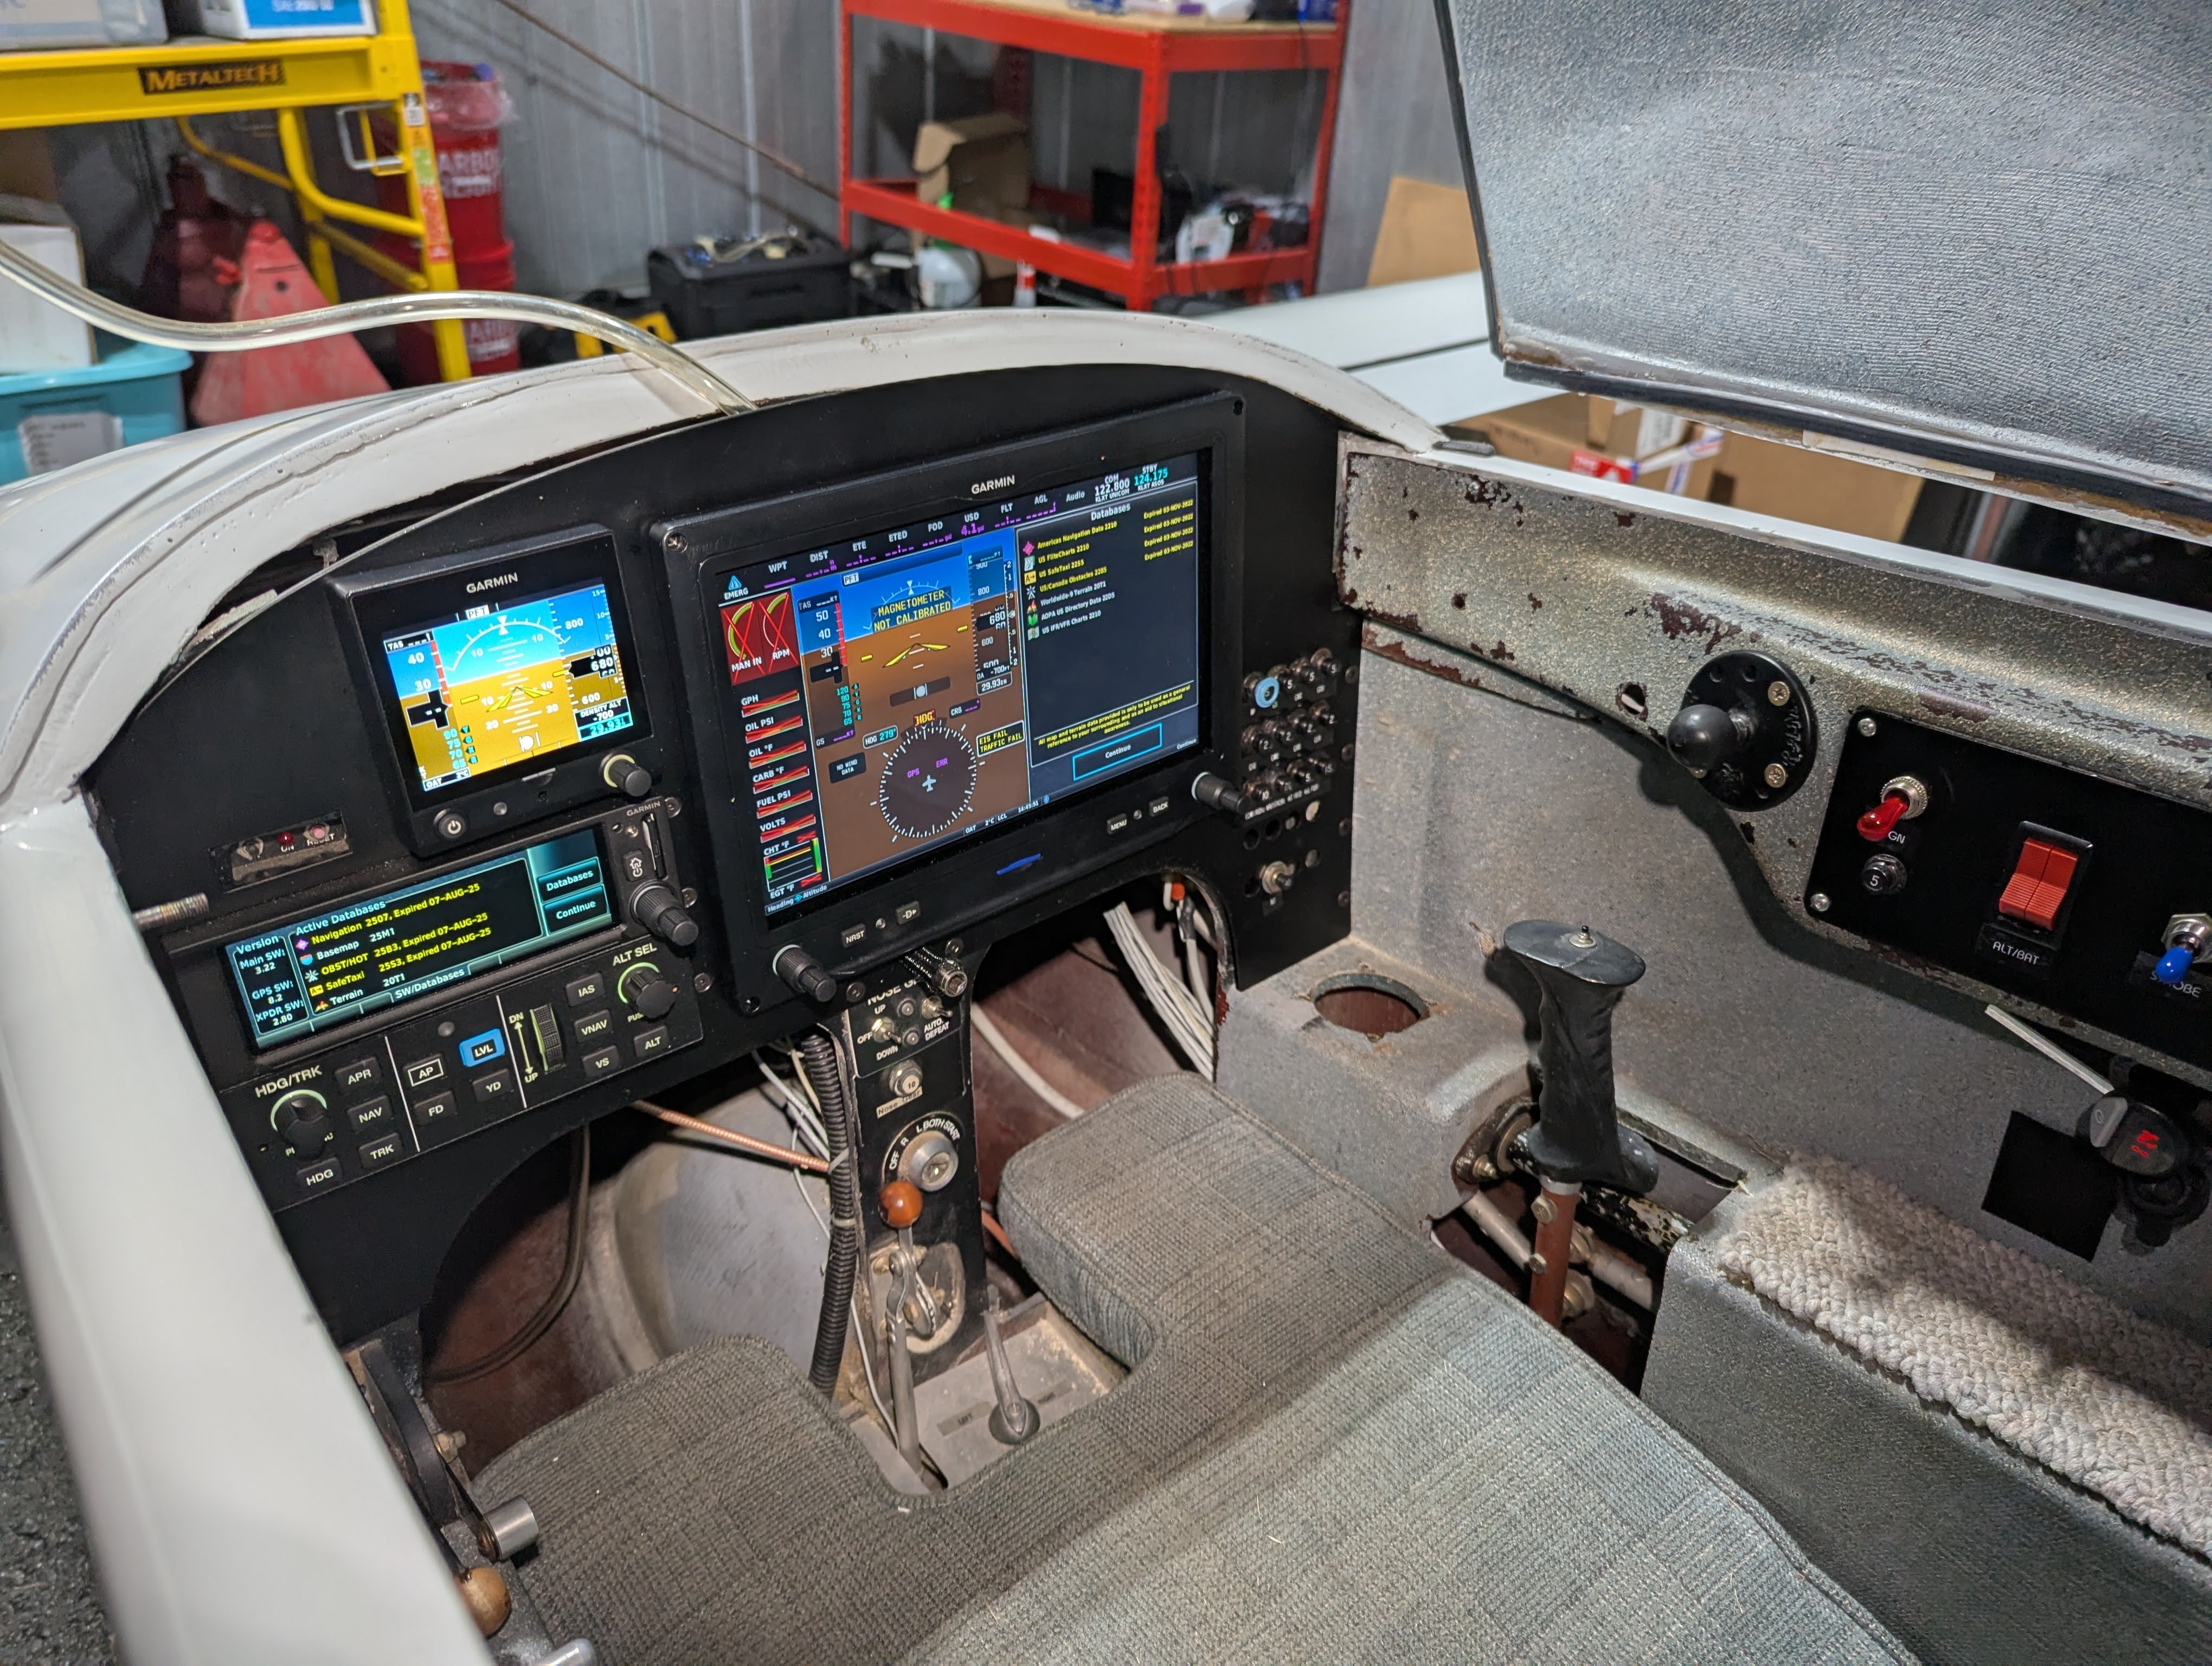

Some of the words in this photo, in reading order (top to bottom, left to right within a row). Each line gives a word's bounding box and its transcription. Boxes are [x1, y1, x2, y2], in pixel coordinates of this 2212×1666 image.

[1104, 473, 1119, 484] COM
[1134, 467, 1168, 486] 124.175
[971, 474, 1015, 495] GARMIN
[1095, 477, 1130, 497] 122.800
[1091, 503, 1130, 521] Databases
[723, 587, 749, 600] EMERG
[768, 561, 788, 573] WPT
[809, 550, 829, 563] DIST
[852, 541, 867, 552] ETE
[889, 529, 908, 543] ETED
[928, 521, 943, 533] FOD
[964, 511, 979, 523] USD
[1001, 502, 1013, 514] FLT
[1034, 494, 1048, 505] AGL
[1066, 490, 1085, 503] Audio
[1037, 538, 1062, 549] Americas
[1063, 530, 1090, 543] Navigation
[466, 573, 518, 594] GARMIN
[845, 574, 858, 584] PFT
[1040, 579, 1068, 592] US/Canada
[1069, 571, 1094, 583] Obstacles
[978, 586, 989, 596] 800
[1074, 585, 1092, 596] Terrain
[799, 600, 811, 610] TAS
[878, 589, 944, 617] MAGNETOMETER
[1041, 611, 1056, 620] AOPA
[1065, 601, 1088, 613] Directory
[1089, 596, 1102, 605] Data
[468, 607, 486, 618] PFT
[816, 610, 828, 622] 50
[874, 618, 890, 632] NOT
[896, 601, 951, 625] CALIBRATED
[989, 611, 1006, 625] 680
[565, 617, 584, 630] 800
[1071, 615, 1088, 625] Charts
[819, 627, 831, 639] 40
[387, 640, 404, 651] TAS
[981, 637, 993, 646] 600
[408, 652, 425, 664] 40
[772, 649, 790, 660] RPM
[821, 646, 833, 658] 30
[591, 657, 613, 671] 680
[732, 659, 750, 672] MAN
[753, 656, 762, 666] IN
[1331, 664, 1337, 674] 5
[1309, 672, 1315, 682] 5
[415, 678, 432, 691] 30
[1287, 680, 1293, 689] 5
[581, 692, 601, 705] 600
[741, 694, 759, 706] GPH
[580, 705, 607, 719] DENSITY
[609, 699, 622, 710] ALT
[745, 721, 759, 732] OIL
[760, 716, 774, 727] PSI
[916, 712, 933, 726] HDG
[1069, 724, 1086, 734] terrain
[1098, 710, 1121, 725] provided
[979, 735, 992, 745] EIS
[993, 729, 1008, 740] FAIL
[980, 738, 1006, 753] TRAFFIC
[1008, 733, 1023, 744] FAIL
[1047, 736, 1071, 749] reference
[749, 747, 763, 758] OIL
[1105, 745, 1131, 758] Continue
[753, 768, 775, 783] CARB
[907, 768, 920, 778] GPS
[426, 778, 442, 788] OAT
[756, 794, 776, 808] FUEL
[777, 790, 791, 802] PSI
[626, 800, 660, 817] GARMIN
[1153, 802, 1168, 813] BACK
[965, 825, 976, 834] OAT
[997, 813, 1007, 822] LCL
[1018, 799, 1039, 814] 14:45:51
[760, 817, 786, 832] VOLTS
[1110, 819, 1127, 831] MENU
[1888, 830, 1906, 844] GN
[763, 844, 780, 856] CHT
[546, 869, 594, 892] Databases
[1870, 874, 1880, 887] 5
[767, 898, 794, 913] Heading
[803, 885, 827, 899] Altitude
[770, 887, 785, 899] EGT
[311, 923, 362, 945] Navigation
[365, 913, 393, 927] 2507,
[393, 900, 428, 918] Expired
[428, 883, 480, 906] 07-AUG-25
[556, 900, 596, 920] Continue
[295, 918, 329, 936] Active
[331, 899, 386, 925] Databases
[236, 935, 279, 954] Version
[317, 940, 359, 960] Basemap
[369, 927, 395, 943] 25M1
[321, 953, 369, 975] OBST/HOT
[373, 943, 402, 958] 25B3,
[402, 930, 436, 948] Expired
[437, 912, 488, 935] 07-AUG-25
[846, 931, 864, 944] NRST
[240, 954, 264, 970] Main
[265, 949, 285, 961] SW:
[326, 970, 365, 991] SafeTaxi
[378, 958, 405, 972] 25S3,
[406, 945, 440, 963] Expired
[441, 927, 492, 951] 07-AUG-25
[613, 950, 632, 966] ALT
[635, 943, 657, 957] SEL
[1992, 940, 2040, 965] ALT/BAT
[255, 962, 276, 975] 3.22
[252, 986, 273, 1000] GPS
[274, 980, 294, 992] SW:
[329, 989, 364, 1005] Terrain
[382, 973, 405, 987] 20T1
[395, 969, 465, 999] SW/Databases
[578, 984, 595, 997] IAS
[2149, 971, 2202, 998] SOBE
[268, 994, 283, 1004] 8.2
[255, 1007, 283, 1022] XPDR
[285, 999, 304, 1011] SW:
[874, 1004, 886, 1015] UP
[272, 1014, 293, 1026] 2.80
[509, 1012, 524, 1024] DN
[581, 1019, 607, 1036] VNAV
[924, 1018, 944, 1033] AUTO.
[925, 1021, 950, 1041] DEFEAT
[645, 1036, 661, 1050] ALT
[857, 1031, 873, 1044] OFF
[474, 1044, 493, 1057] LVL
[876, 1046, 898, 1061] DOWN
[595, 1058, 609, 1069] VS
[348, 1068, 371, 1085] APR
[419, 1066, 433, 1079] AP
[524, 1072, 538, 1084] UP
[255, 1065, 323, 1098] HDG/TRK
[486, 1081, 501, 1093] YD
[359, 1107, 382, 1124] NAV
[428, 1104, 443, 1117] FD
[878, 1102, 898, 1115] Nose
[889, 1151, 899, 1170] OFF
[901, 1137, 909, 1146] R
[916, 1125, 922, 1133] L
[923, 1118, 944, 1131] BOTH
[944, 1120, 960, 1141] START
[370, 1144, 394, 1159] TRK
[306, 1169, 334, 1186] HDG
